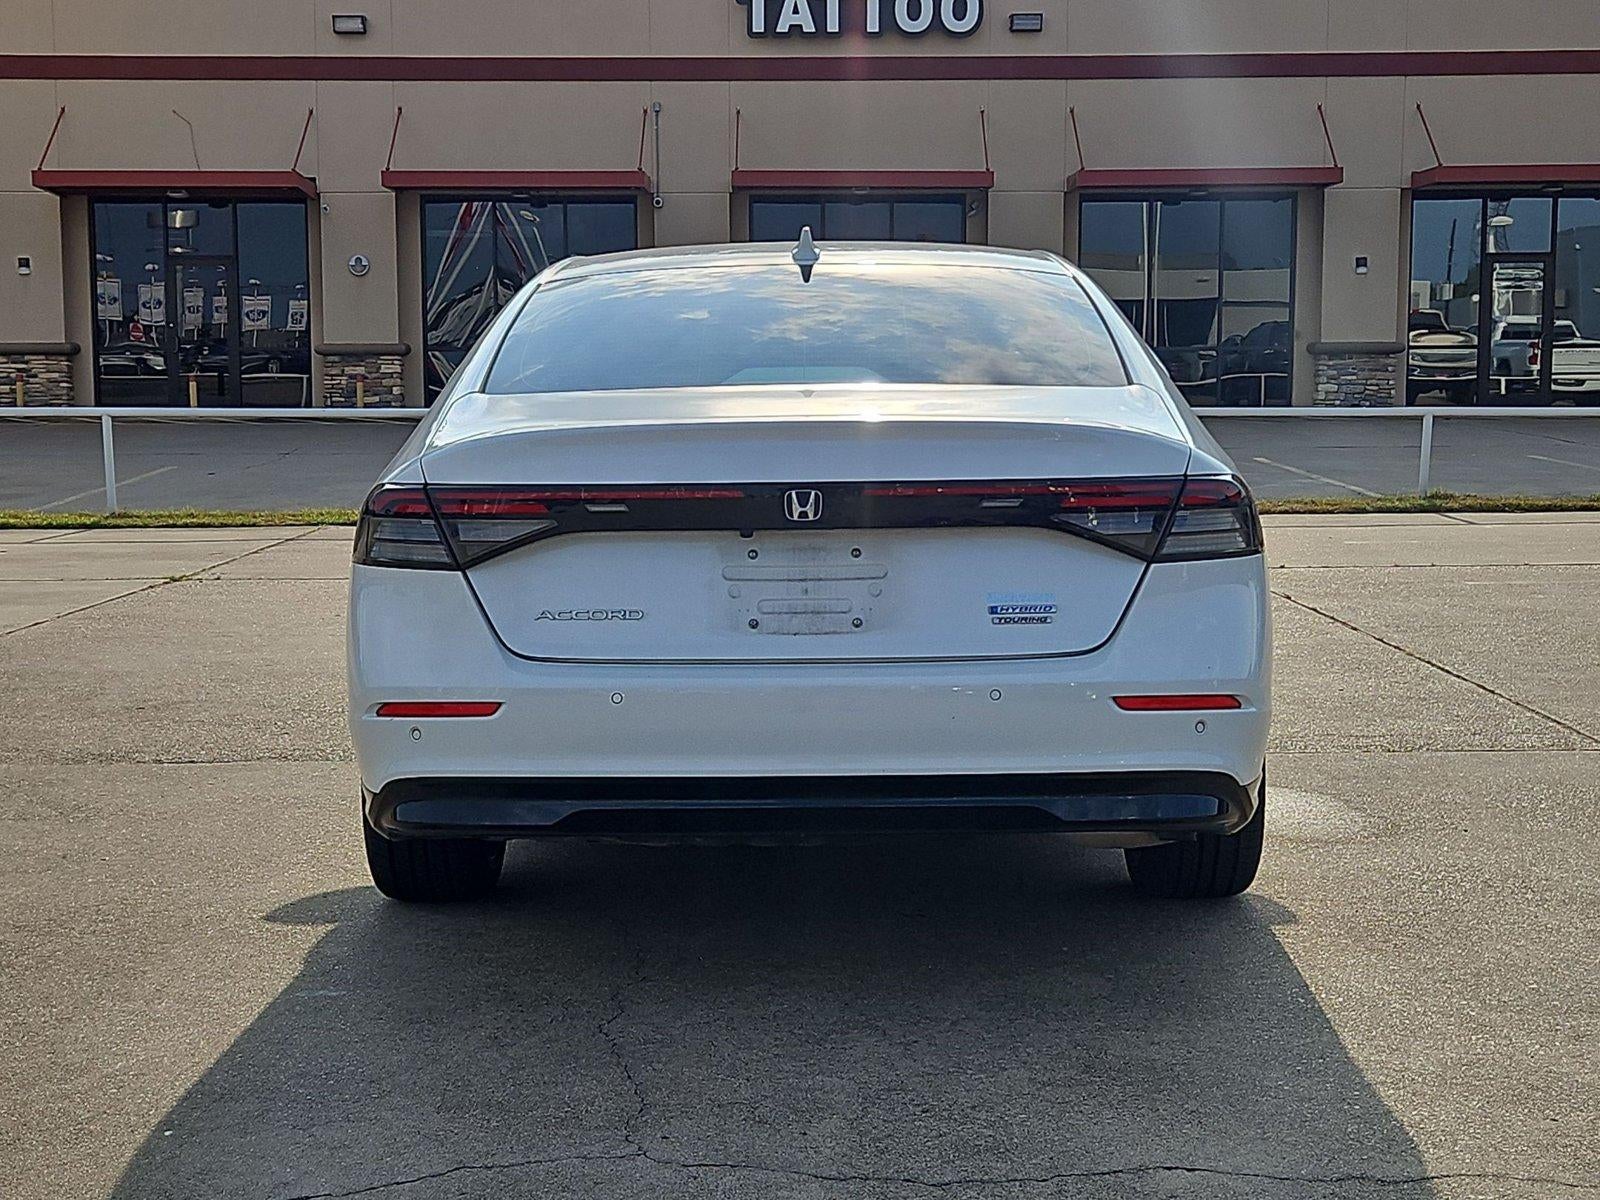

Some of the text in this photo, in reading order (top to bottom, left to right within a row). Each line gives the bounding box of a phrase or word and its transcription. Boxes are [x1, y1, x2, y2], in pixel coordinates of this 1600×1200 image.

[998, 604, 1054, 614] HYBRID
[534, 609, 644, 621] ACCORD
[995, 616, 1050, 624] TOURING
